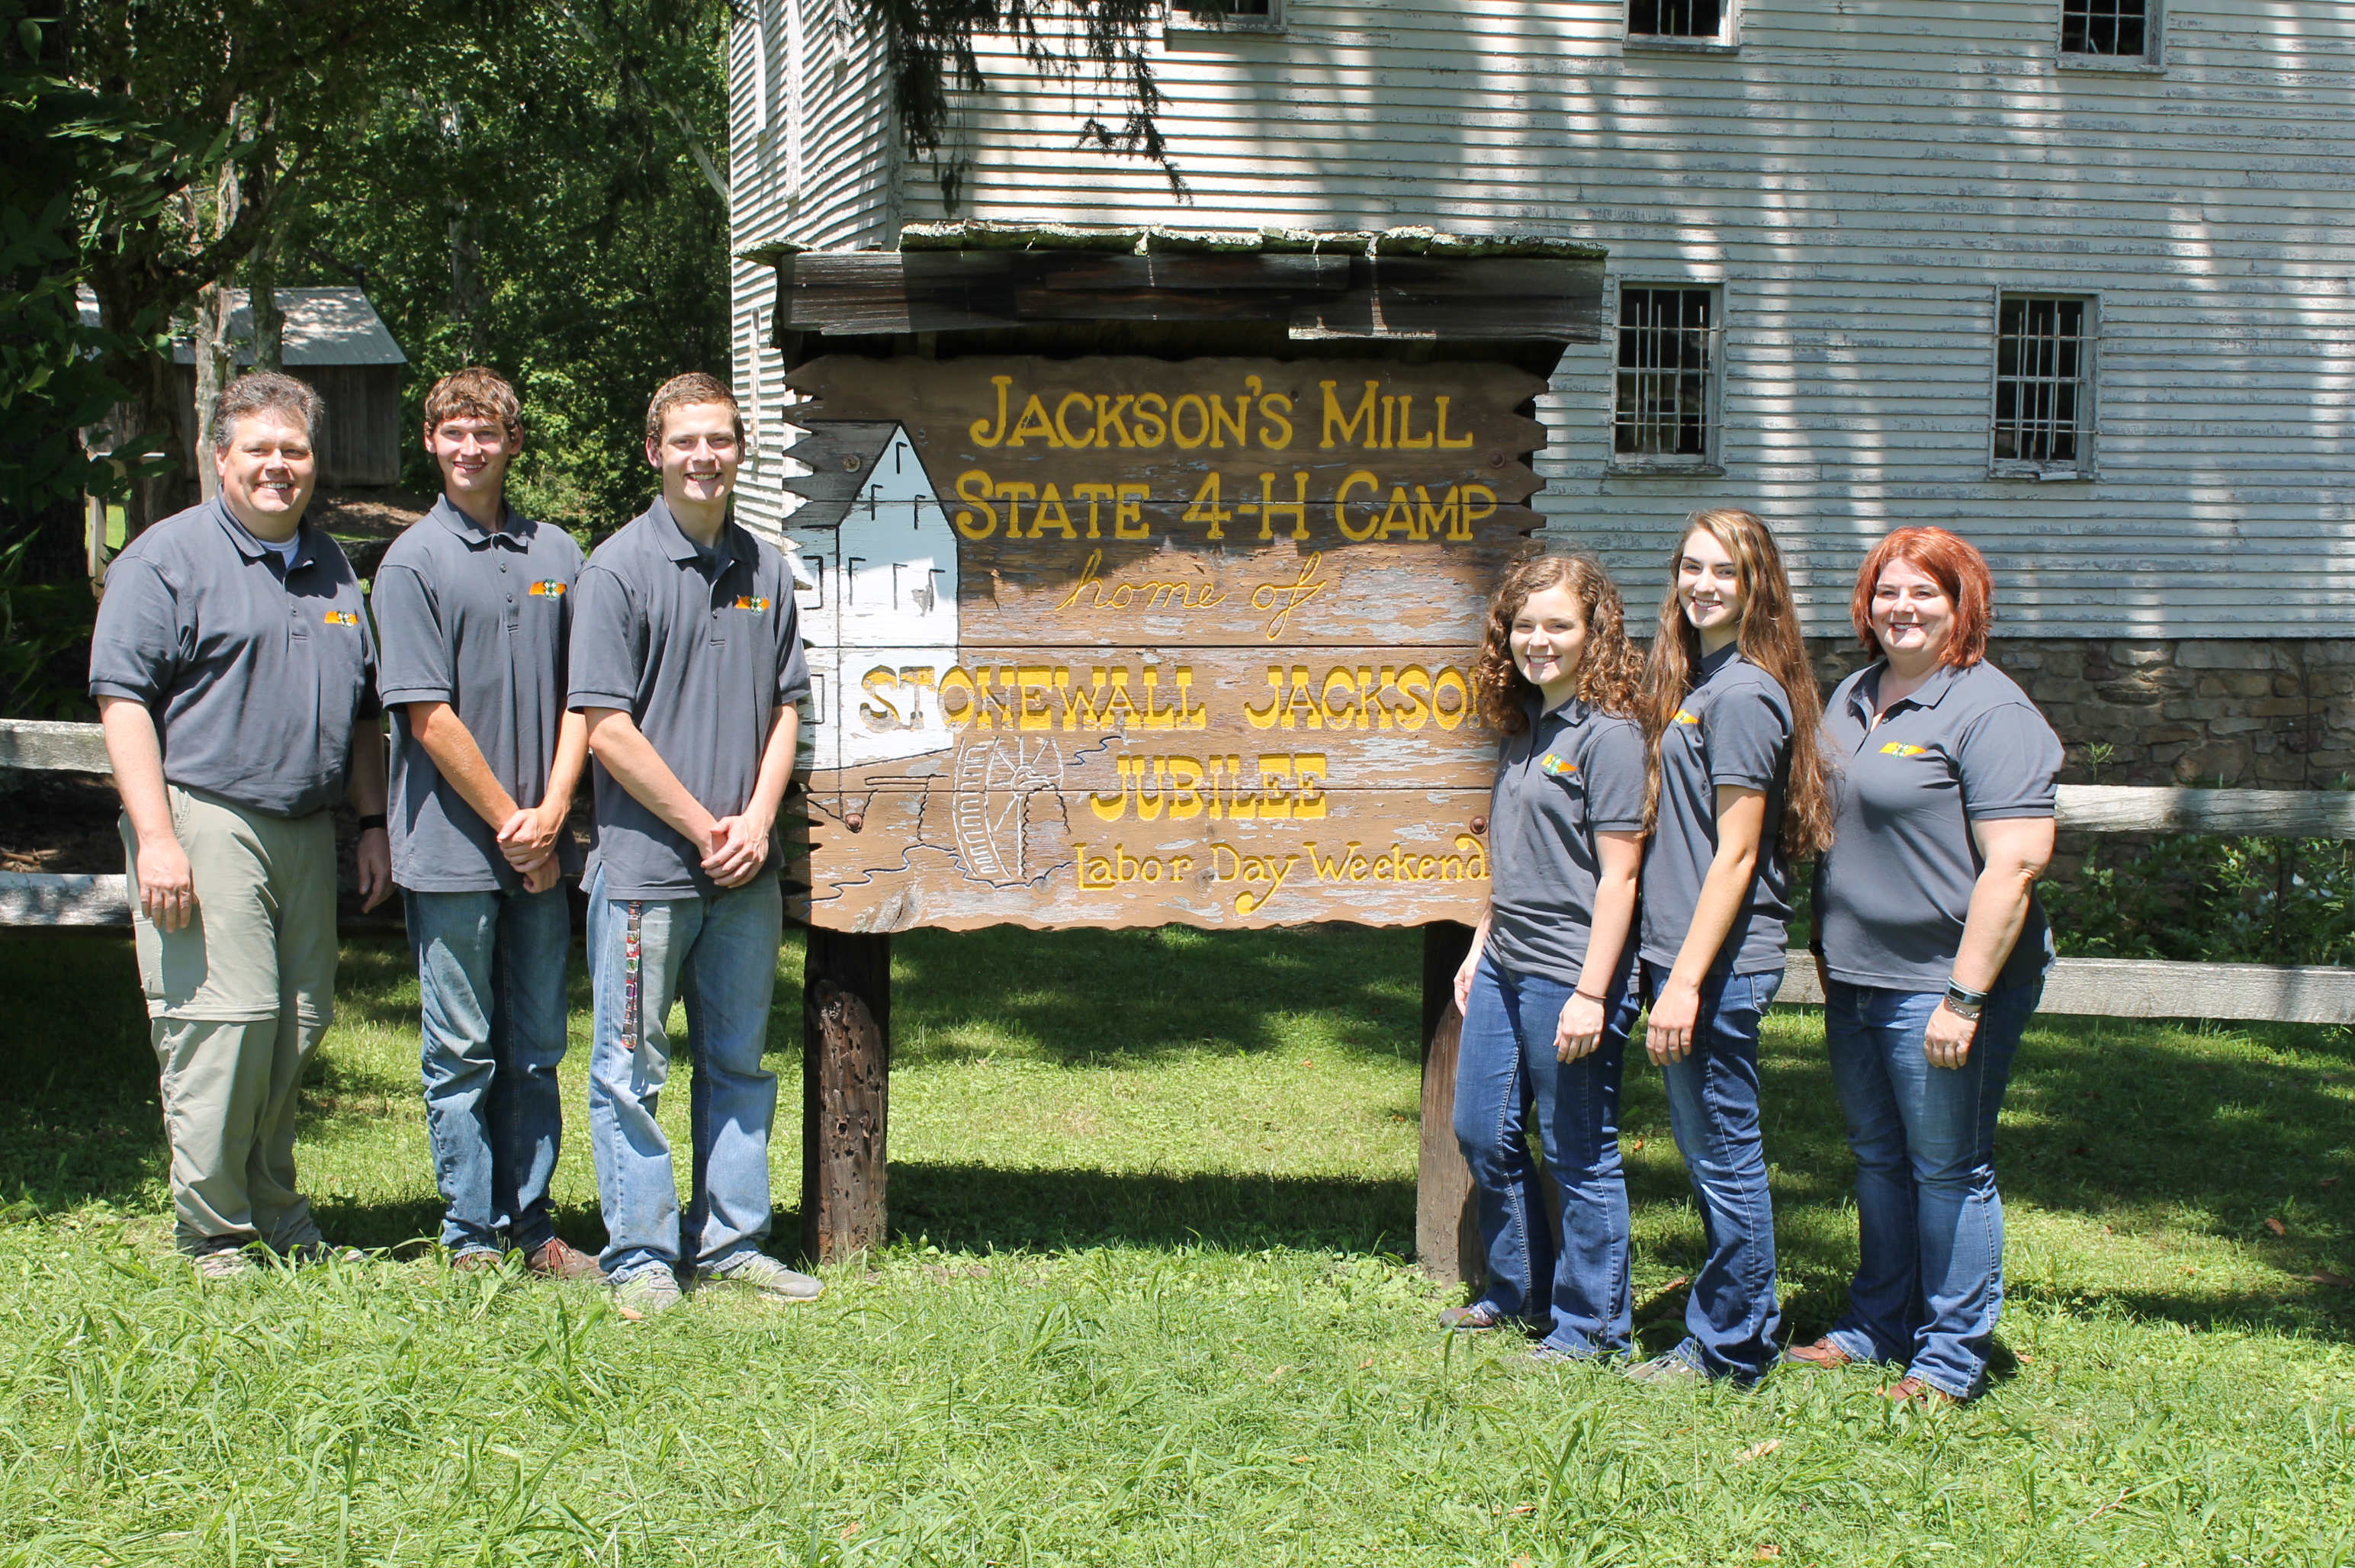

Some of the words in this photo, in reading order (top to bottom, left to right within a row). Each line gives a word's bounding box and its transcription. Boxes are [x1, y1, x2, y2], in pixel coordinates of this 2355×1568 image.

[970, 375, 1293, 450] JACKSON'S
[1319, 380, 1473, 448] MILL
[956, 469, 1151, 540] STATE
[1183, 471, 1309, 540] 4-H
[1335, 470, 1498, 541] CAMP
[1055, 548, 1226, 611] home
[1251, 551, 1327, 641] of
[859, 665, 1206, 732] STONEWALL
[1245, 665, 1482, 731] JACKSO
[1090, 754, 1327, 821] JUBILEE
[1074, 842, 1194, 891] Labor
[1210, 843, 1300, 916] Day
[1303, 833, 1490, 882] Weekend
